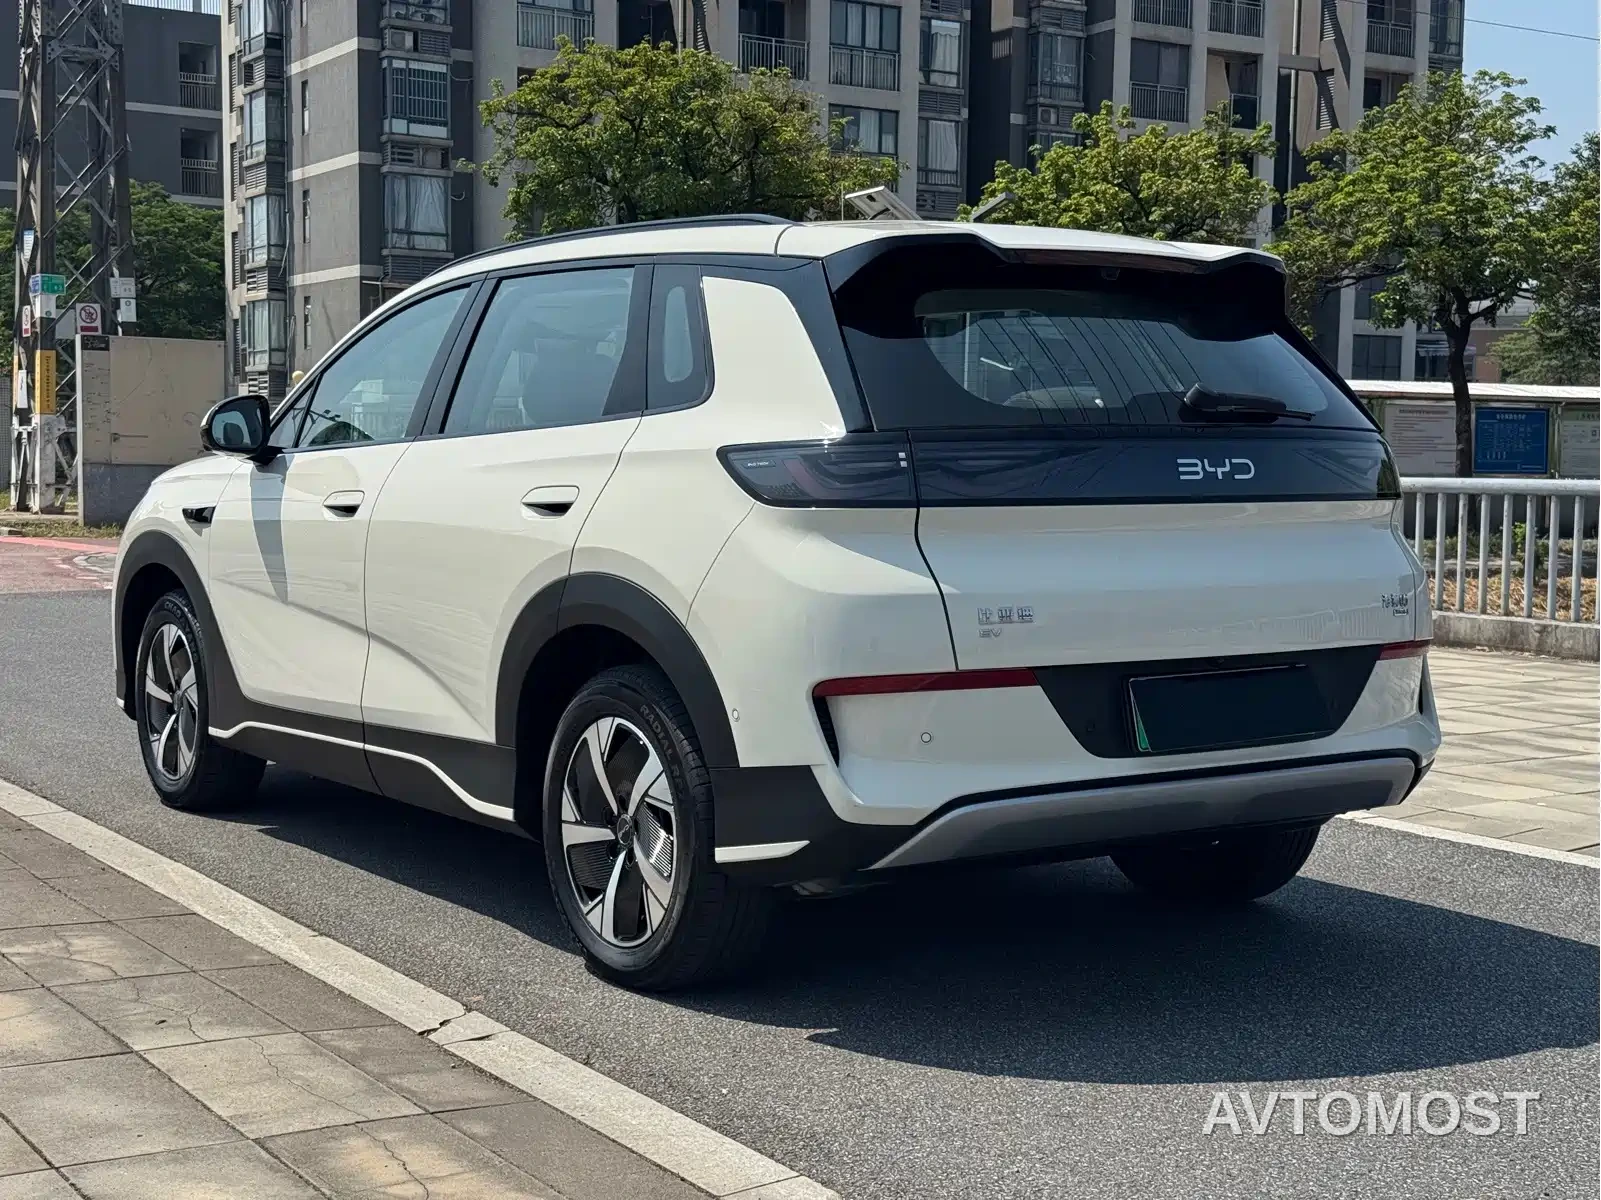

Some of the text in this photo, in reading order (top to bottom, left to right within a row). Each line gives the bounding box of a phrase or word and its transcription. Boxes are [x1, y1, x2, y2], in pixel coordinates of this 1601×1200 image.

[1176, 458, 1255, 480] BYD
[979, 628, 1002, 638] EV
[640, 704, 673, 761] RADIAL
